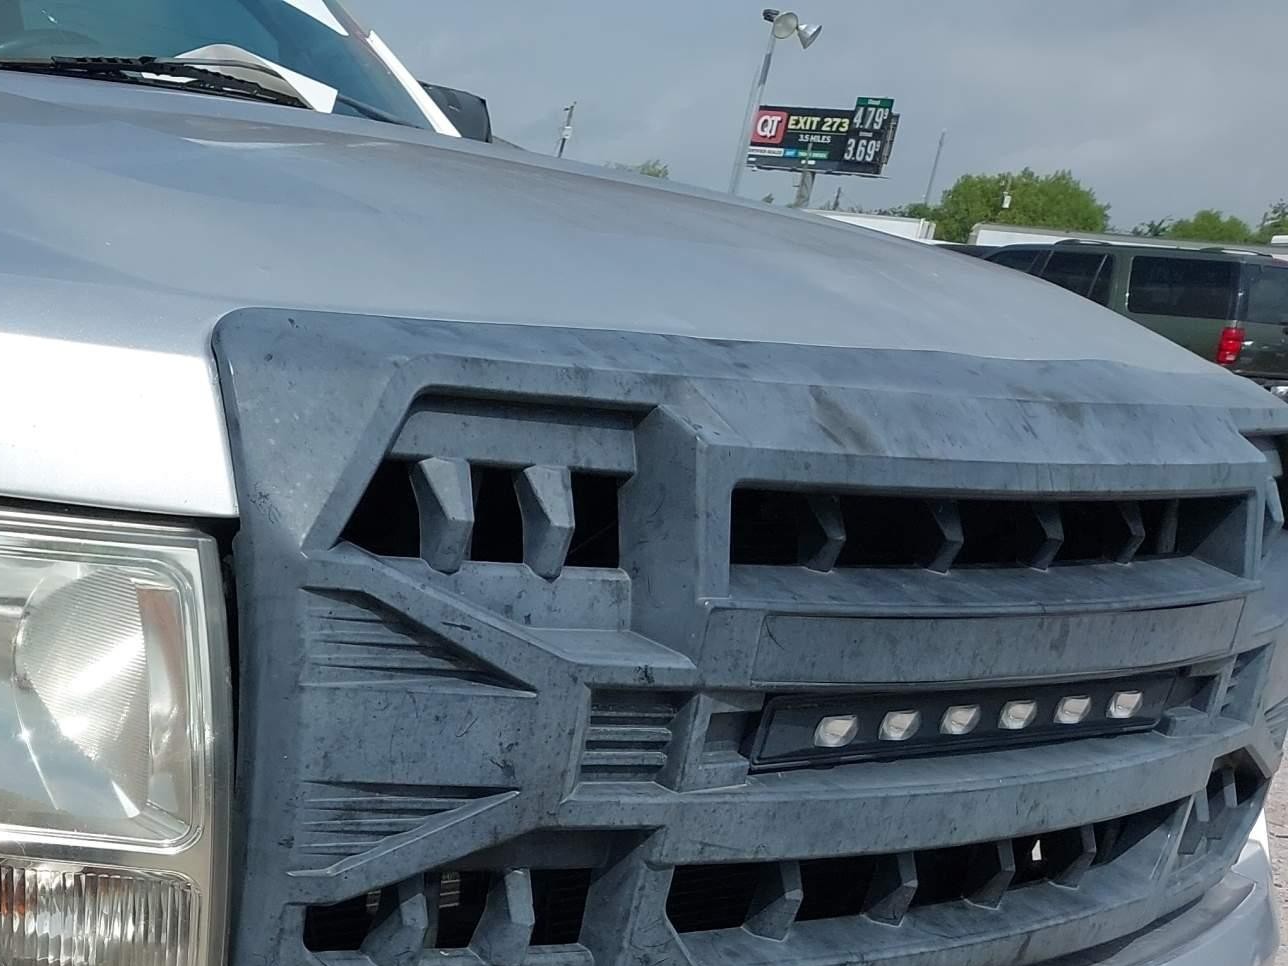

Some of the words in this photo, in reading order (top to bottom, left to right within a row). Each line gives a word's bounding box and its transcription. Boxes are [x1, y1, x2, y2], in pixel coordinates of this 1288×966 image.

[757, 115, 781, 138] QT
[787, 115, 819, 130] EXIT
[821, 117, 849, 131] 273
[809, 135, 831, 143] MILES
